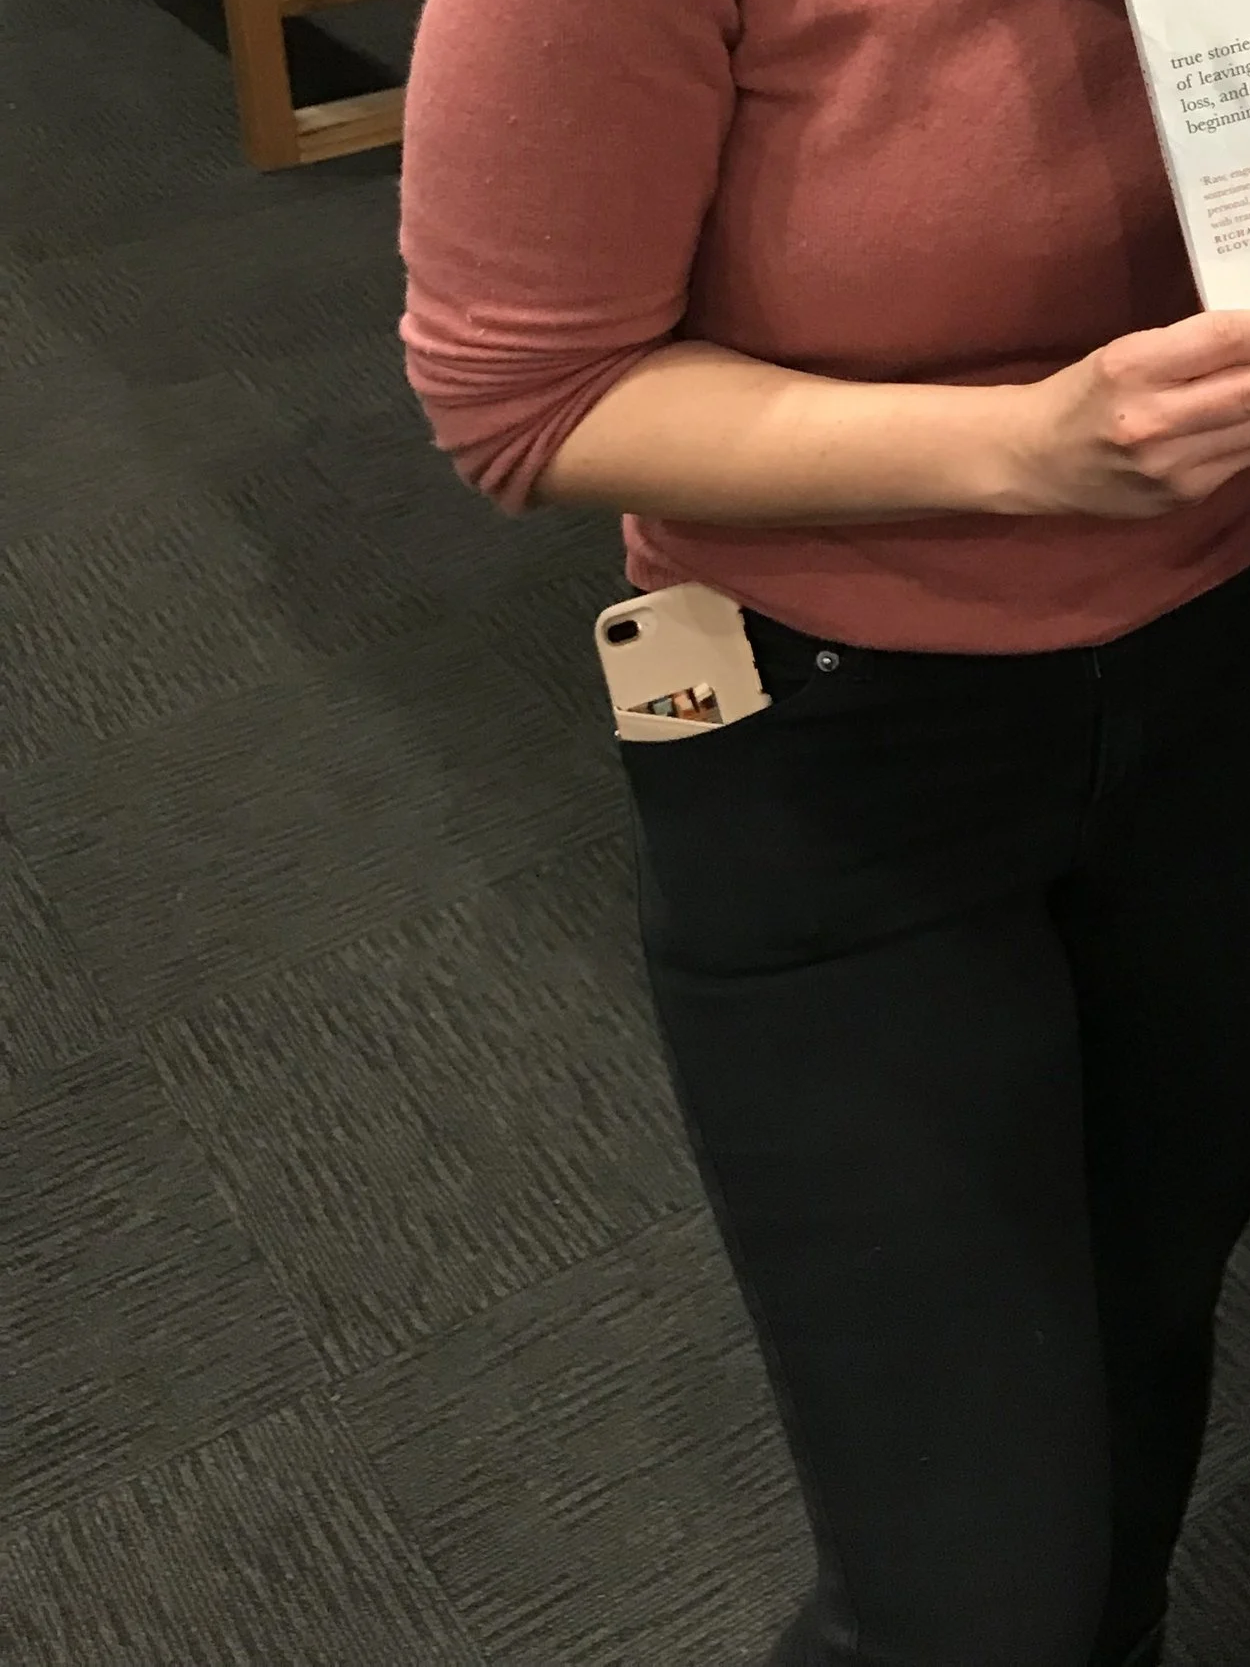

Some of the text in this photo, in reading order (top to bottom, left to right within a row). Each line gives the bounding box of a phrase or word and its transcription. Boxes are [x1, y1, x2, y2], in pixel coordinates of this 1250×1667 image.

[1171, 52, 1202, 69] true
[1176, 75, 1192, 91] of
[1181, 98, 1216, 113] loss,
[1220, 83, 1250, 104] and
[1211, 216, 1232, 229] with
